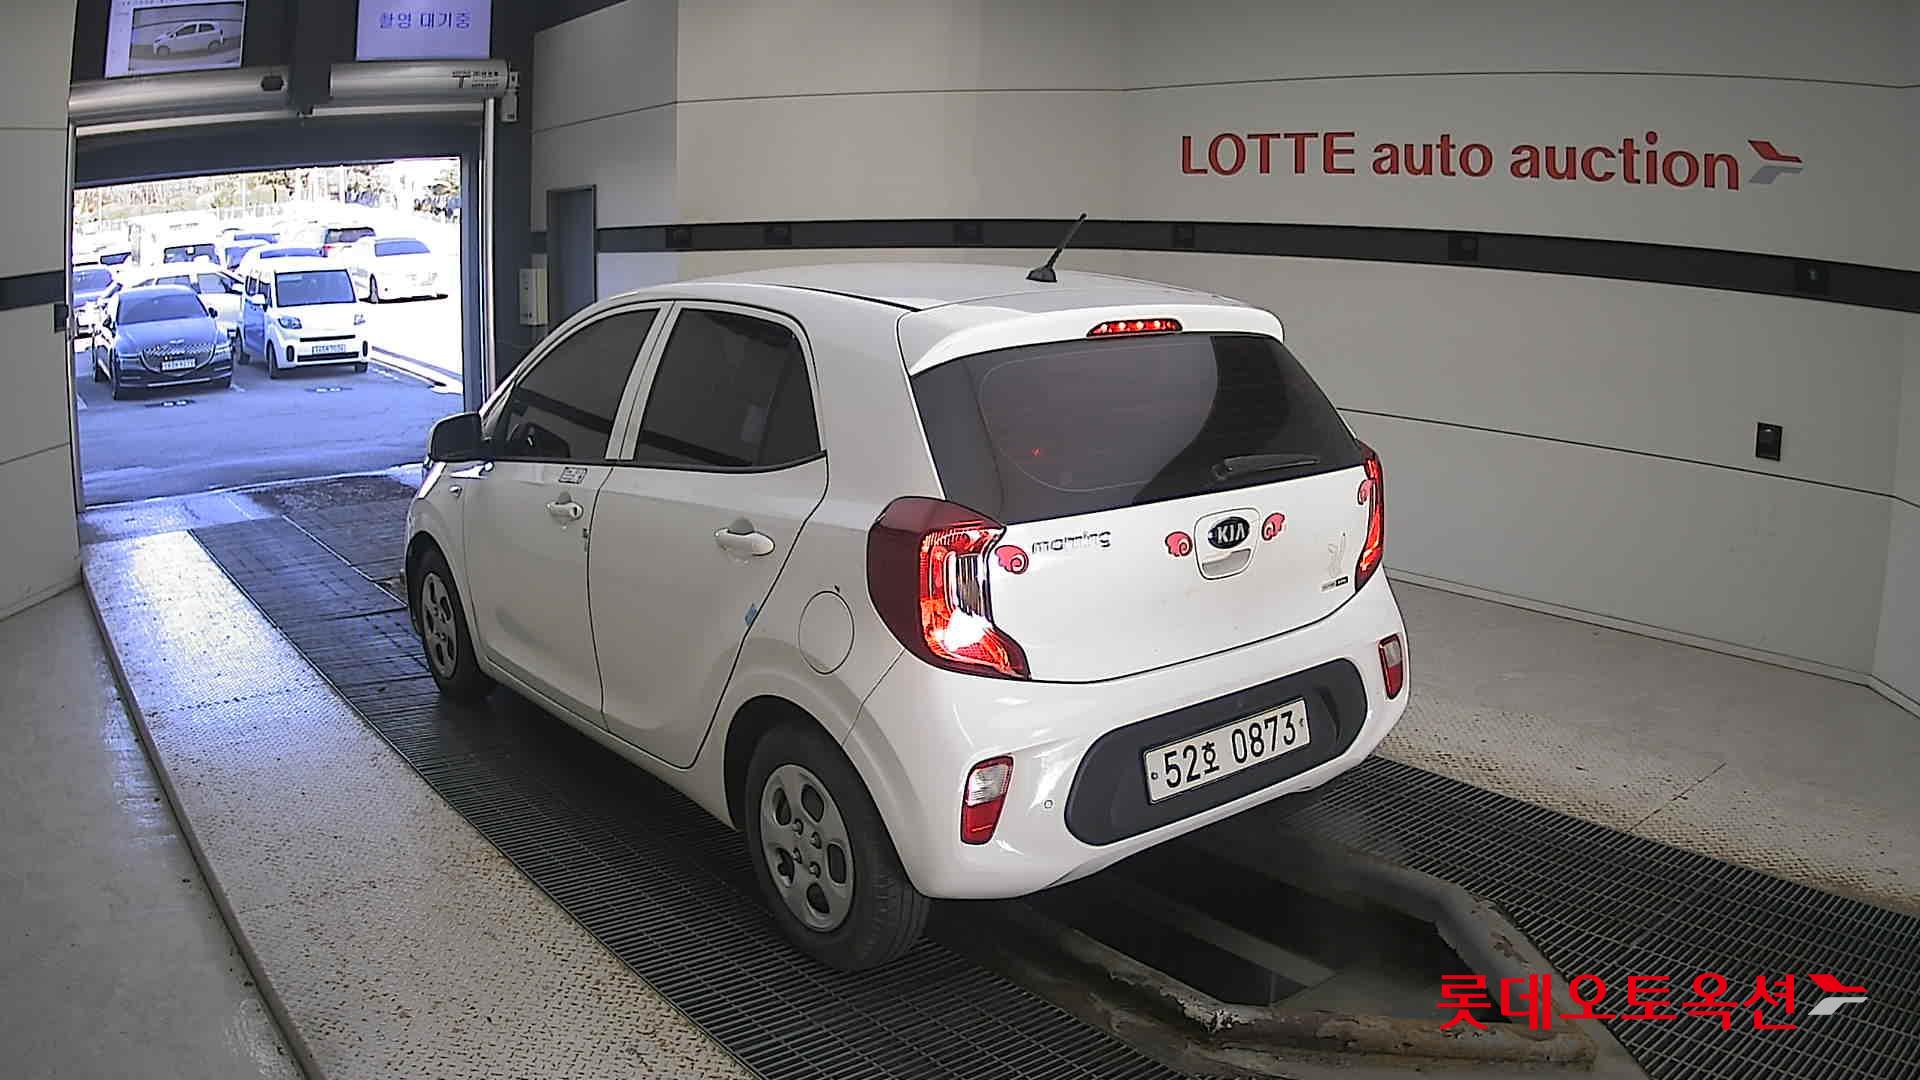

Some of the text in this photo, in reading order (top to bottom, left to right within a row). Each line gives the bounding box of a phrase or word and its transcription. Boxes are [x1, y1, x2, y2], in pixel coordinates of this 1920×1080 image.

[420, 12, 470, 29] 대기중
[1181, 131, 1740, 190] LOTTE auto auction
[1217, 522, 1246, 544] KIA
[1164, 710, 1296, 788] 52호 0873
